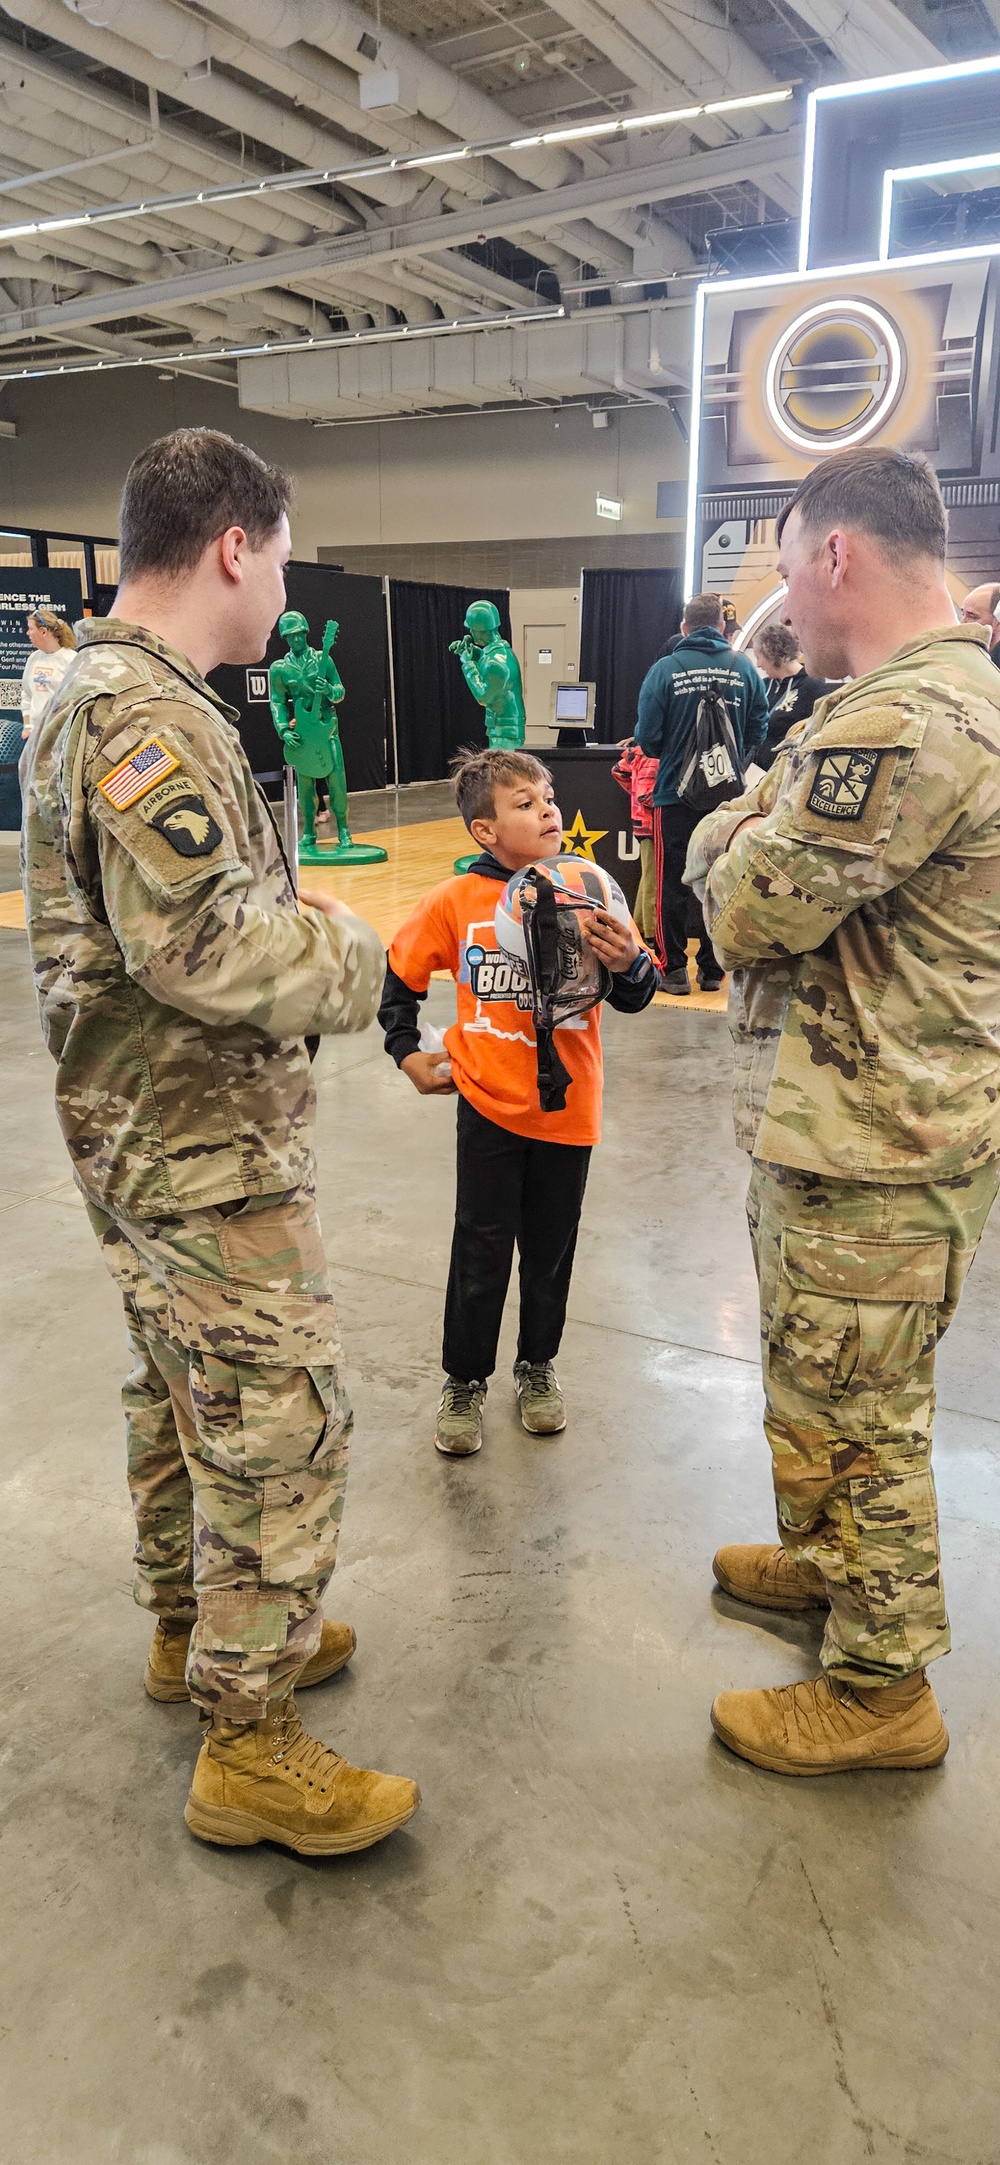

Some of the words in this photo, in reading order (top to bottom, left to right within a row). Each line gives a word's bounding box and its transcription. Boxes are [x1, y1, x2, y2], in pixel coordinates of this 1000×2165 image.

[28, 594, 51, 603] THE
[0, 602, 36, 611] RLESS
[38, 603, 67, 612] GEN1
[687, 668, 708, 677] person
[708, 667, 730, 675] behind
[250, 676, 266, 696] W
[730, 679, 745, 687] place
[707, 753, 725, 777] 90
[143, 781, 192, 814] AIRBORNE
[811, 796, 858, 815] EXCELLENCE
